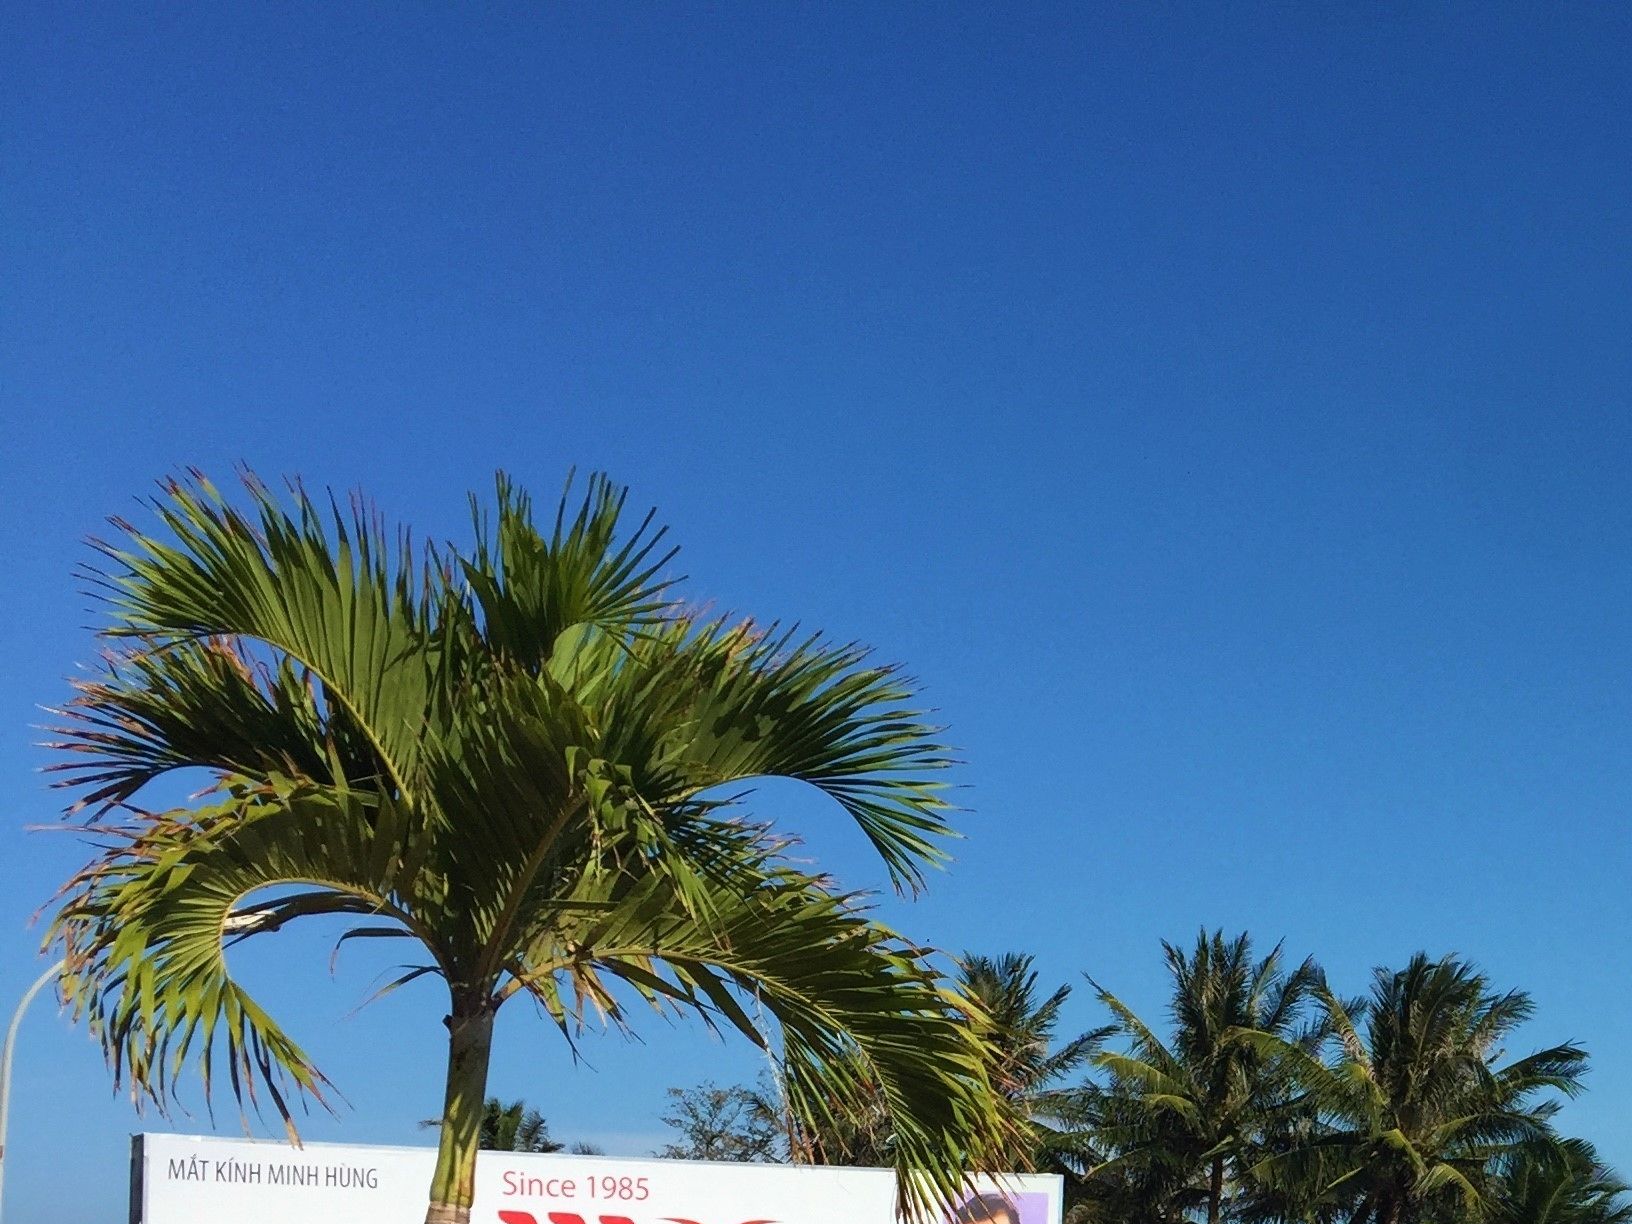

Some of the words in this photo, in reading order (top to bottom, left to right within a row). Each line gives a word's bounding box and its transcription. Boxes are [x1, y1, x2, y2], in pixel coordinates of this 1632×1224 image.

[168, 1153, 209, 1181] MẮT
[215, 1157, 261, 1184] KÍNH
[267, 1163, 319, 1186] MINH
[325, 1163, 378, 1189] HÙNG
[502, 1170, 576, 1198] Since
[587, 1175, 649, 1201] 1985
